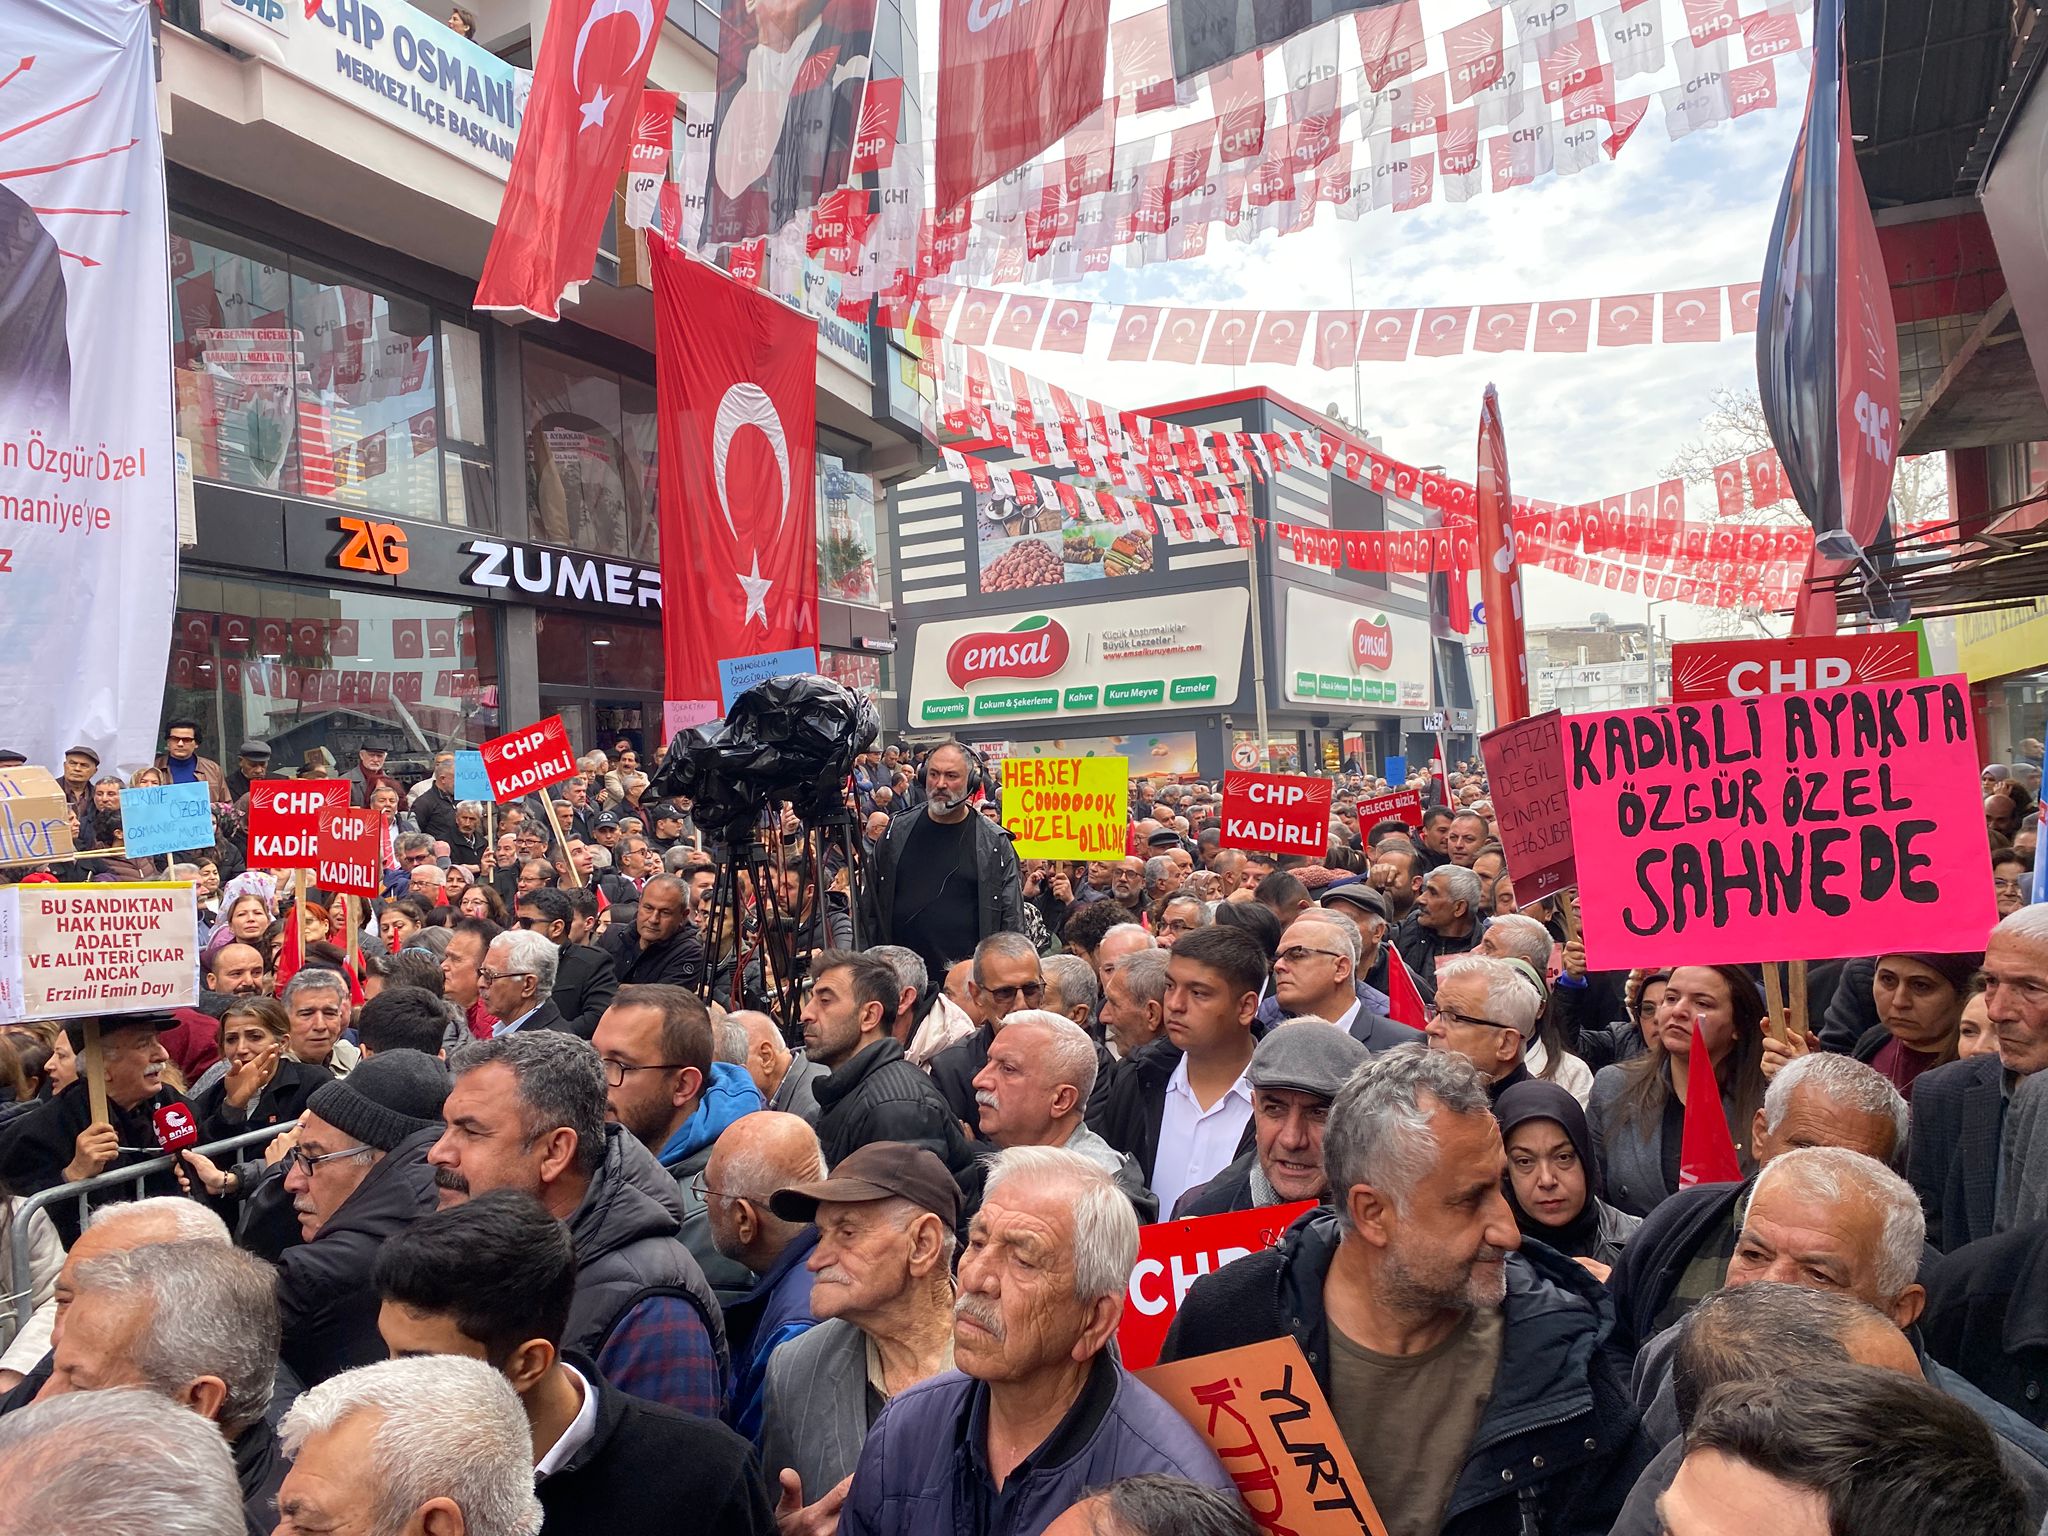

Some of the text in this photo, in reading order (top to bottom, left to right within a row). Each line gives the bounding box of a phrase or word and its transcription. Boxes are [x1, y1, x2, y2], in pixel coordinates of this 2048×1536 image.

[1750, 37, 1790, 57] CHP
[336, 48, 407, 107] MERKEZ
[411, 84, 445, 127] İLÇE
[393, 25, 523, 129] OSMANİ
[1120, 75, 1160, 100] CHP
[1295, 64, 1336, 90] CHP
[1686, 71, 1721, 93] CHP
[1569, 104, 1606, 121] CHP
[686, 123, 714, 139] CHP
[1224, 127, 1261, 152] CHP
[1512, 126, 1544, 143] CHP
[632, 144, 663, 160] CHP
[856, 138, 886, 158] CHP
[1377, 161, 1408, 178] CHP
[1443, 152, 1476, 171] CHP
[1003, 163, 1032, 185] CHP
[1069, 168, 1104, 192] CHP
[1322, 185, 1351, 199] CHP
[815, 222, 844, 239] CHP
[386, 342, 409, 355] CHP
[27, 429, 93, 483] Özgür
[96, 442, 145, 480] Özel
[963, 634, 1051, 671] emsal
[1103, 639, 1130, 651] Büyük
[1359, 631, 1388, 658] emsal
[1584, 671, 1600, 682] HTC
[1728, 657, 1852, 697] CHP
[926, 682, 1210, 714] Kuruyemiş Lokum & Şekerleme Kahve Kuru Meyve Ezmeler
[502, 732, 544, 760] CHP
[1501, 722, 1558, 764] KAZA
[1570, 683, 1968, 790] KADİRLİ AYAKTA
[496, 750, 571, 795] KADİRLİ
[1499, 760, 1559, 797] DEĞİL
[273, 792, 325, 815] CHP
[1248, 783, 1304, 806] CHP
[1617, 763, 1912, 837] ÖZGÜR ÖZEL
[1359, 802, 1394, 816] GELECEK
[332, 817, 364, 841] CHP
[1007, 815, 1126, 854] GÜZEL OLACAK
[1227, 818, 1322, 846] KADİRLİ
[320, 857, 375, 888] KADİRLİ
[1622, 820, 1940, 936] SAHNEDE
[41, 898, 173, 915] BU SANDIKTAN
[56, 916, 160, 932] HAK HUKUK
[74, 933, 142, 950] ADALET
[28, 954, 50, 969] VE
[55, 951, 94, 967] ALIN
[138, 948, 184, 967] ÇIKAR
[83, 966, 140, 982] ANCAK
[46, 982, 174, 1002] Erzinli Emin Dayı
[169, 1125, 194, 1139] anka
